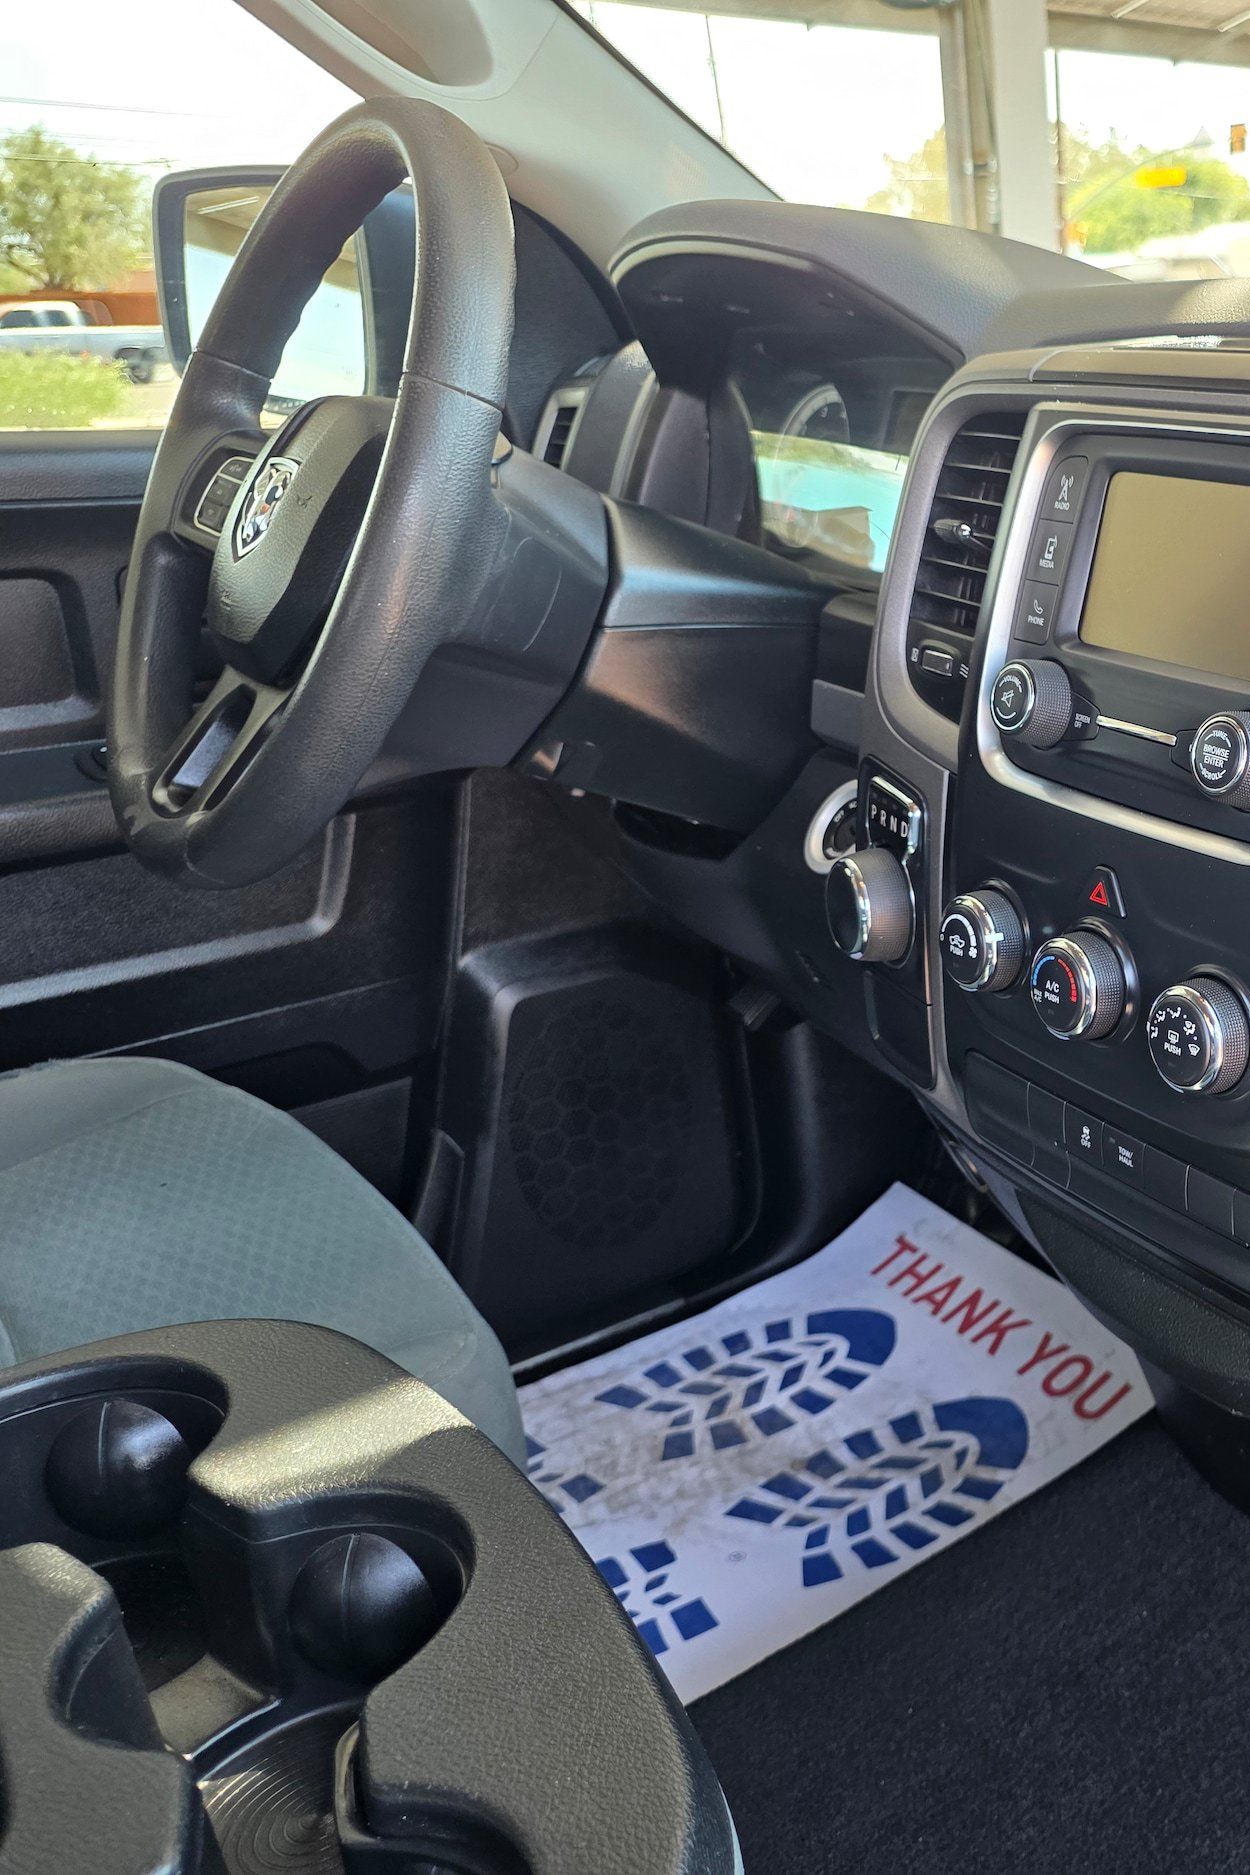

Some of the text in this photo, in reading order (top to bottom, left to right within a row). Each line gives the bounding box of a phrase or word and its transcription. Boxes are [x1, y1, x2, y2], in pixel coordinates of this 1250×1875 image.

[1054, 500, 1071, 511] RADIO
[1039, 558, 1055, 569] MEDIA
[1027, 614, 1045, 627] PHONE
[1074, 721, 1082, 729] OFF
[1075, 713, 1091, 724] SCREEN
[1212, 730, 1228, 740] TUNE
[1203, 744, 1230, 758] BROWSE
[1203, 755, 1224, 768] ENTER
[1201, 767, 1222, 780] SCROLL
[871, 804, 908, 838] P R N D
[950, 945, 963, 957] PUSH
[1045, 980, 1060, 993] A/C
[1044, 991, 1060, 1004] PUSH
[1164, 1042, 1181, 1056] PUSH
[1081, 1139, 1091, 1148] OFF
[1118, 1146, 1134, 1159] TOW/
[1118, 1155, 1134, 1168] HAUL
[871, 1234, 1132, 1421] THANK YOU
